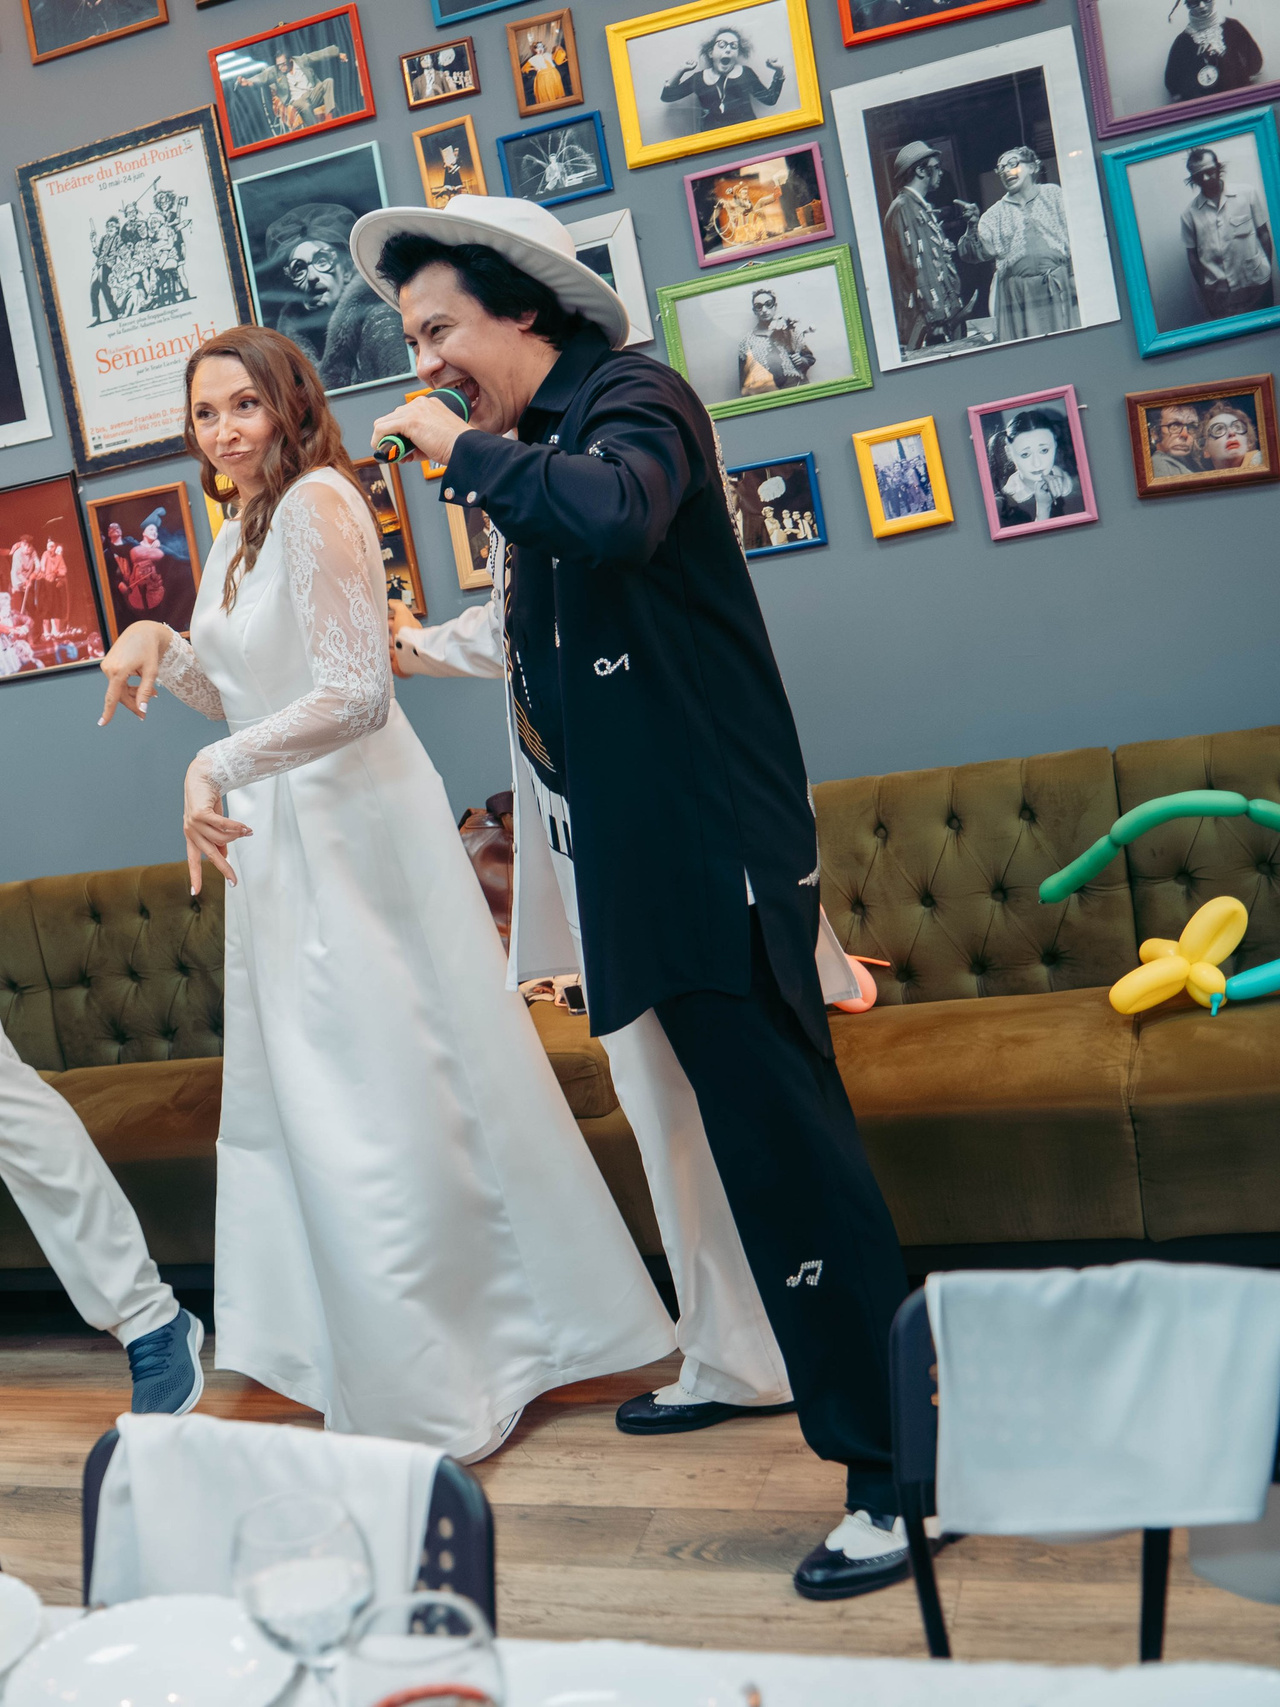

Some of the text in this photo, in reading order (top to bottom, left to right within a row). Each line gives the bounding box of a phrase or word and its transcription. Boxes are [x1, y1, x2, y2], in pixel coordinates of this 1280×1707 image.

[46, 173, 94, 196] Théâtre
[96, 166, 113, 181] du
[114, 144, 184, 175] Rond-Point
[98, 182, 108, 191] 10
[133, 172, 145, 182] juin
[95, 320, 217, 375] Semianyki
[90, 427, 95, 435] 2
[110, 420, 133, 430] avenue
[134, 411, 160, 422] Franklin
